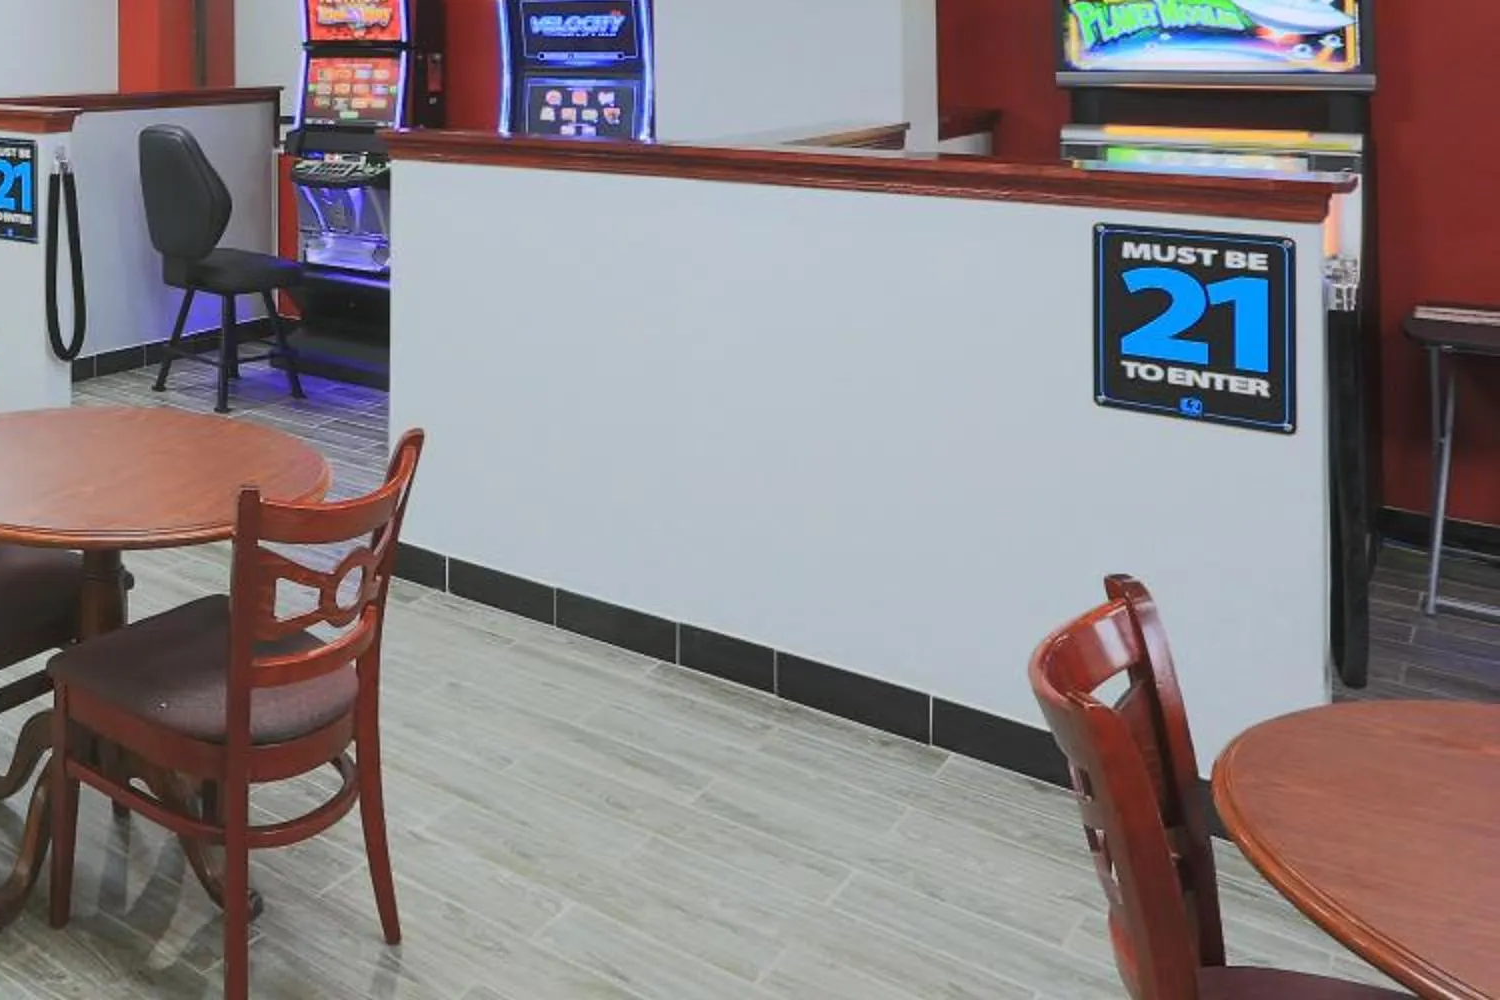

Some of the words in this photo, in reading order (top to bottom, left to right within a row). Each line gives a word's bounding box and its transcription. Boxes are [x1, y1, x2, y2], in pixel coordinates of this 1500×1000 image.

[529, 14, 626, 35] VELOCITY
[1120, 241, 1219, 267] MUST
[1224, 249, 1269, 272] BE
[1120, 266, 1270, 374] 21
[1120, 361, 1165, 382] TO
[1167, 366, 1271, 398] ENTER
